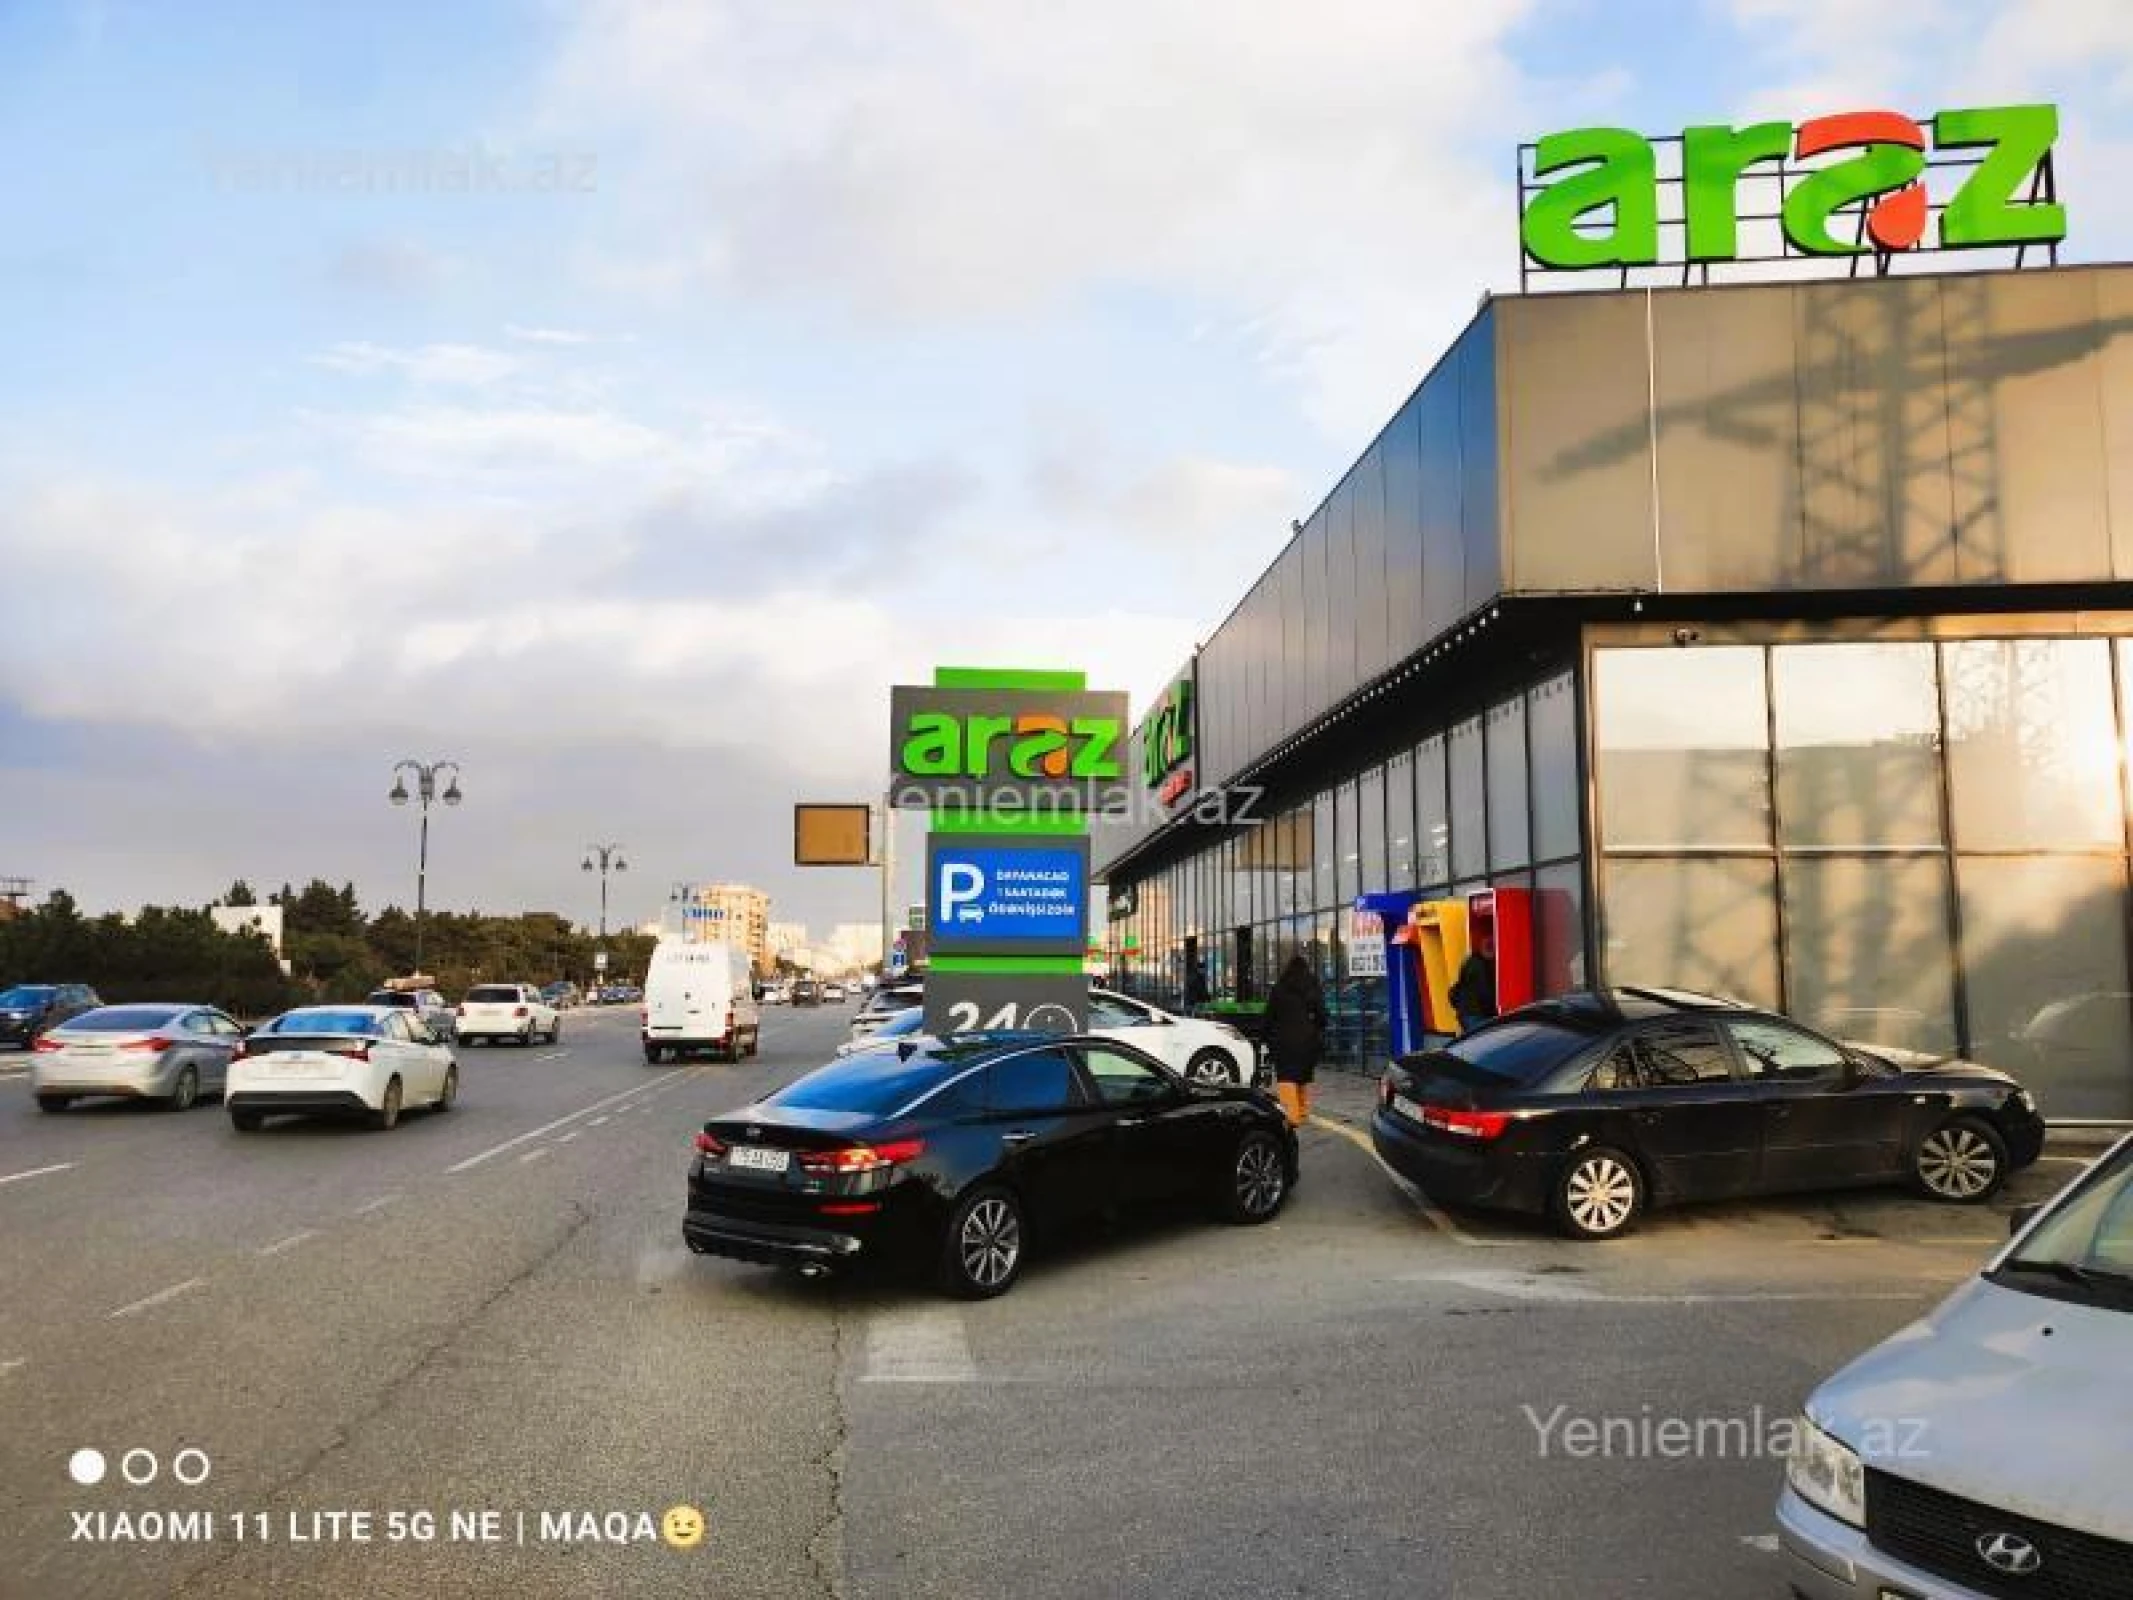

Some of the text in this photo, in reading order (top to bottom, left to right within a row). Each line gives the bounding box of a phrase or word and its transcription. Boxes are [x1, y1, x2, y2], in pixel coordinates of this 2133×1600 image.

[1522, 104, 2067, 270] araz
[902, 711, 1122, 780] araz
[940, 863, 985, 924] P
